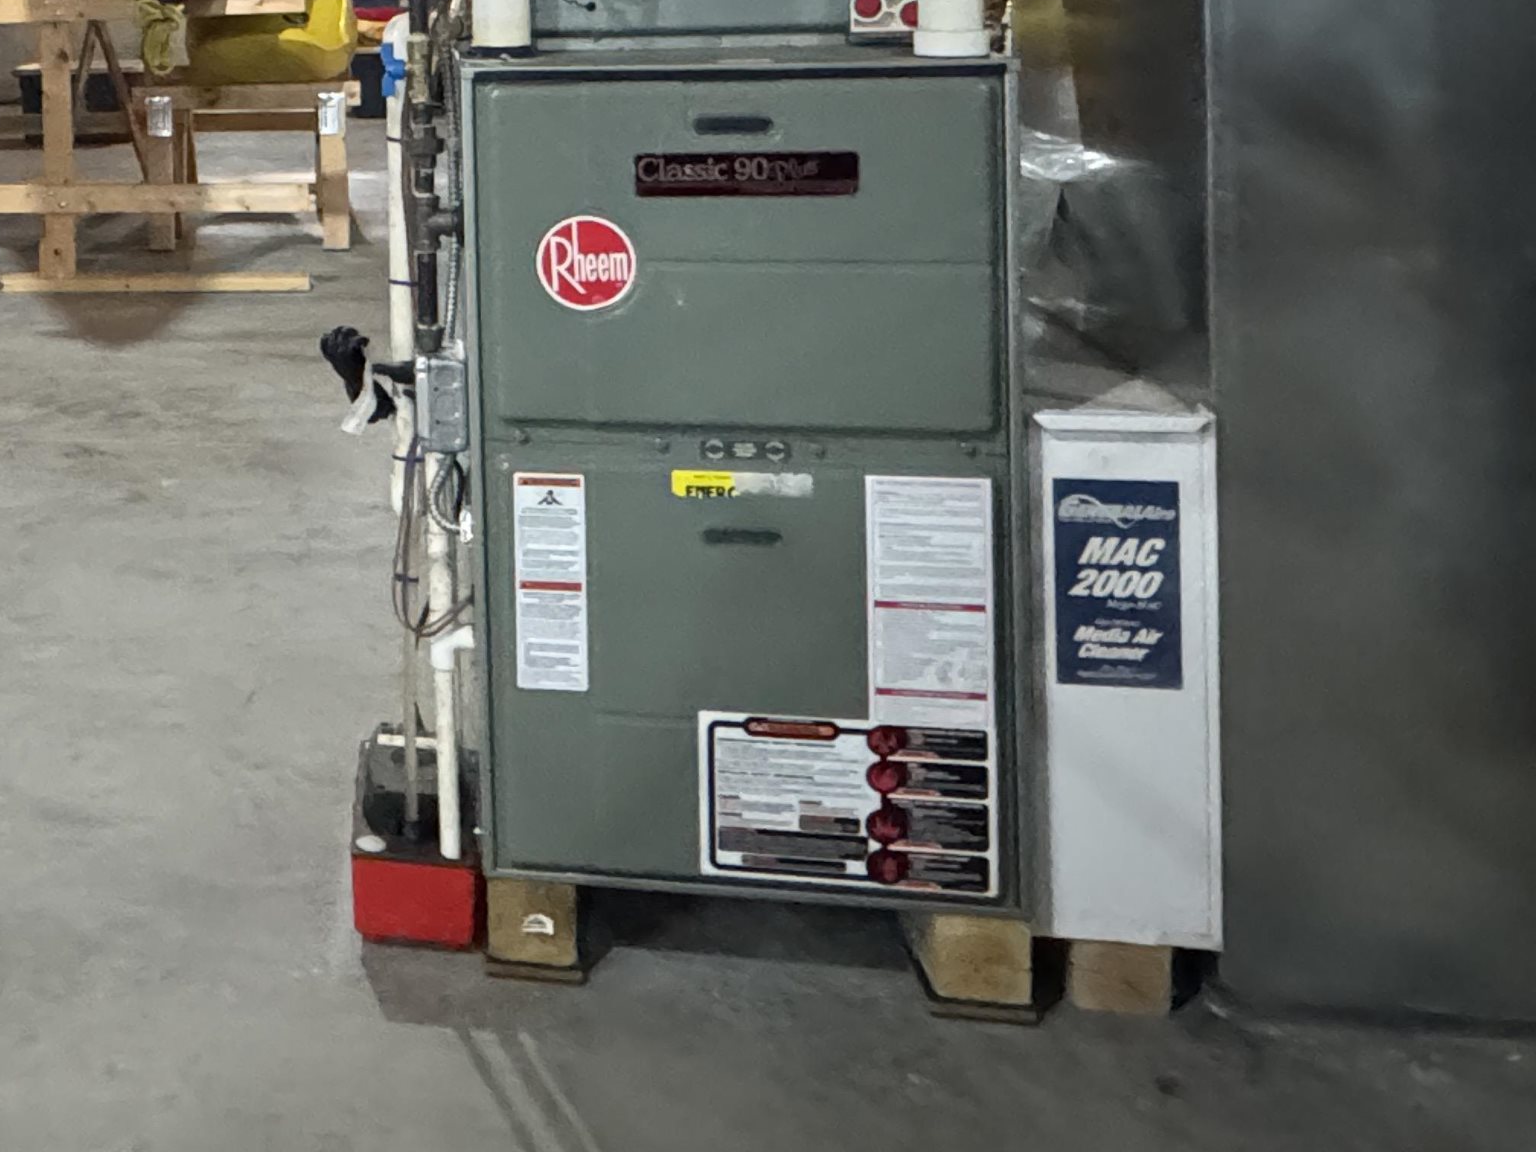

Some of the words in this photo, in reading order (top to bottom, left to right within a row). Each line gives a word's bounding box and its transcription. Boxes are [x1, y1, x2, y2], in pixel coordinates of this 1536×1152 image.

[636, 156, 729, 182] Classic
[733, 156, 768, 181] 90
[549, 219, 628, 294] Rheem
[1077, 536, 1166, 567] MAC
[1067, 568, 1165, 599] 2000
[1073, 625, 1131, 644] Media
[1131, 628, 1164, 645] Air
